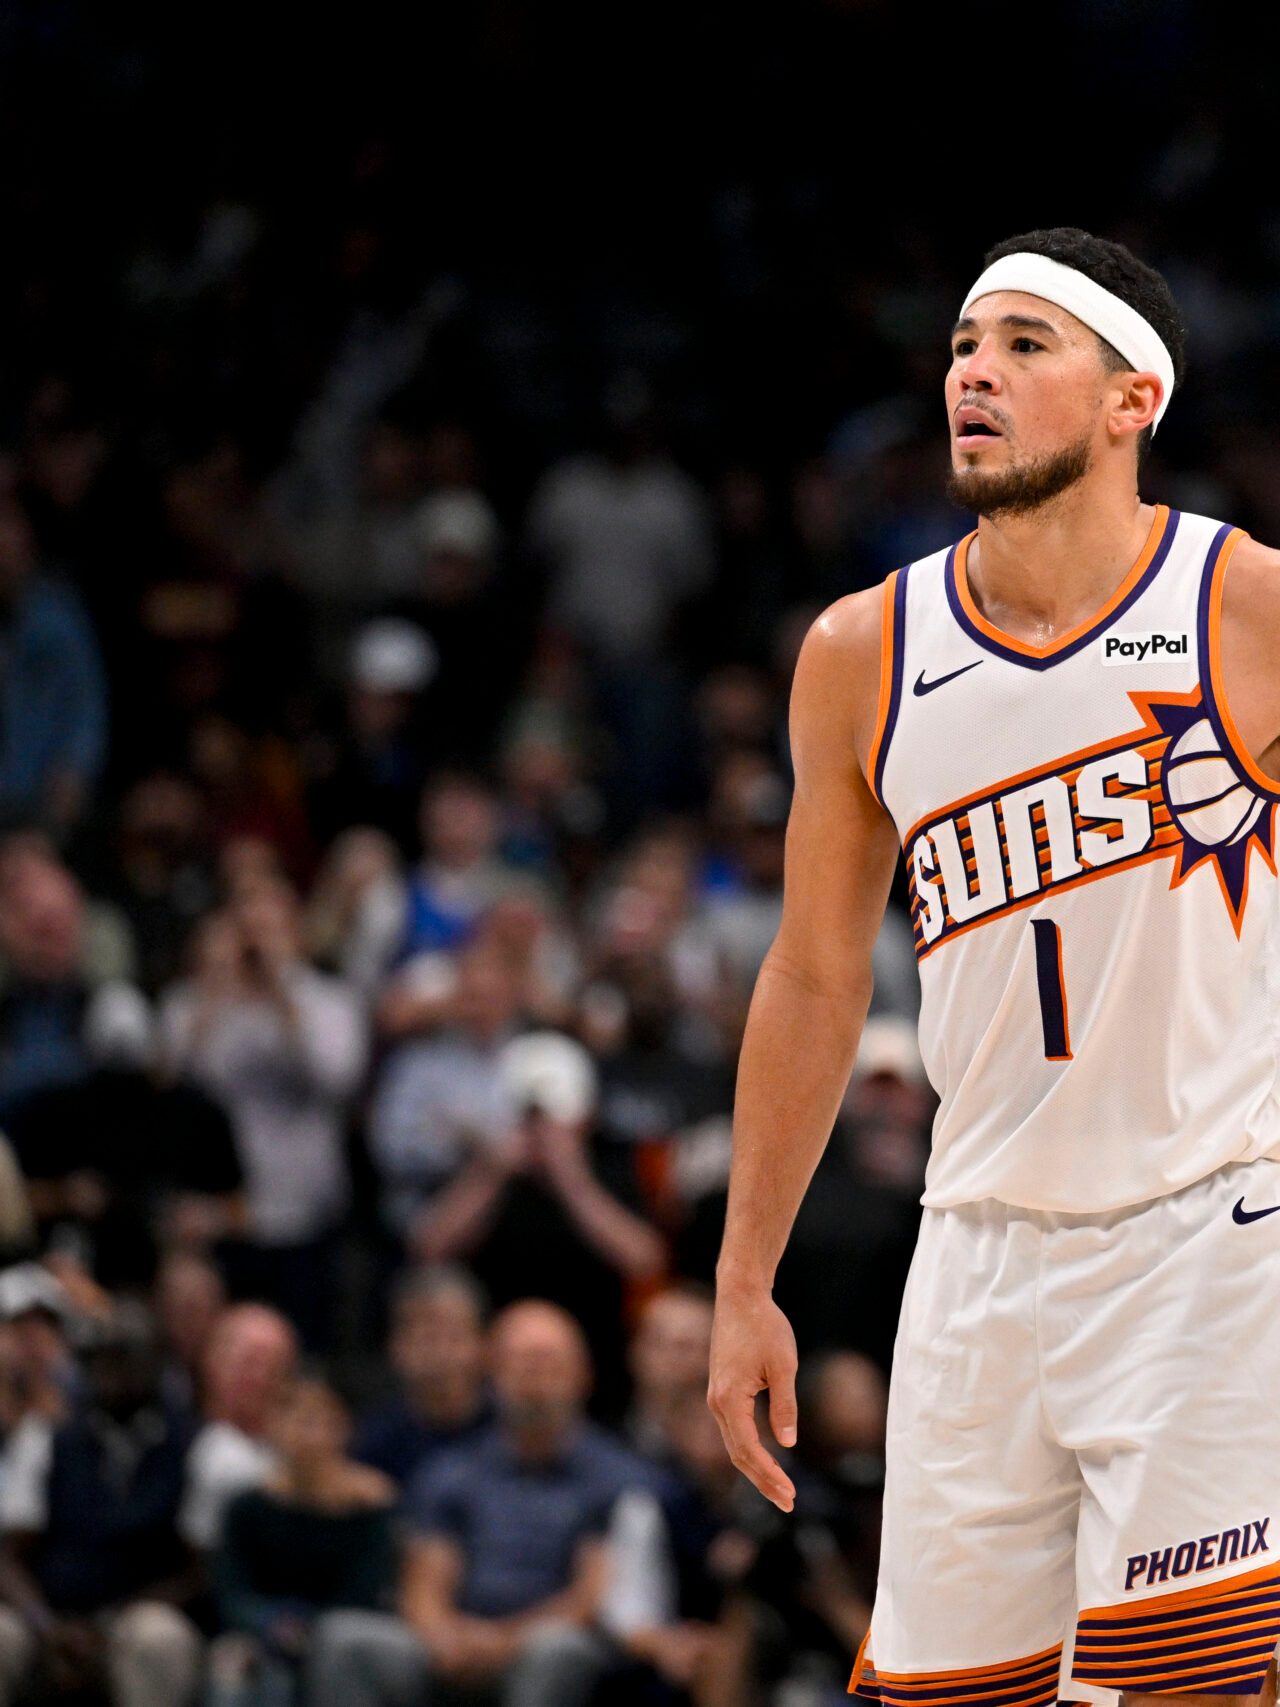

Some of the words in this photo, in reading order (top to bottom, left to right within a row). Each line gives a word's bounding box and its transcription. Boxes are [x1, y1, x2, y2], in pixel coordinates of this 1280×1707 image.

[1106, 635, 1187, 661] PayPal
[912, 749, 1152, 945] SUNS
[1030, 918, 1074, 1062] 1
[1124, 1517, 1270, 1592] PHOENIX
